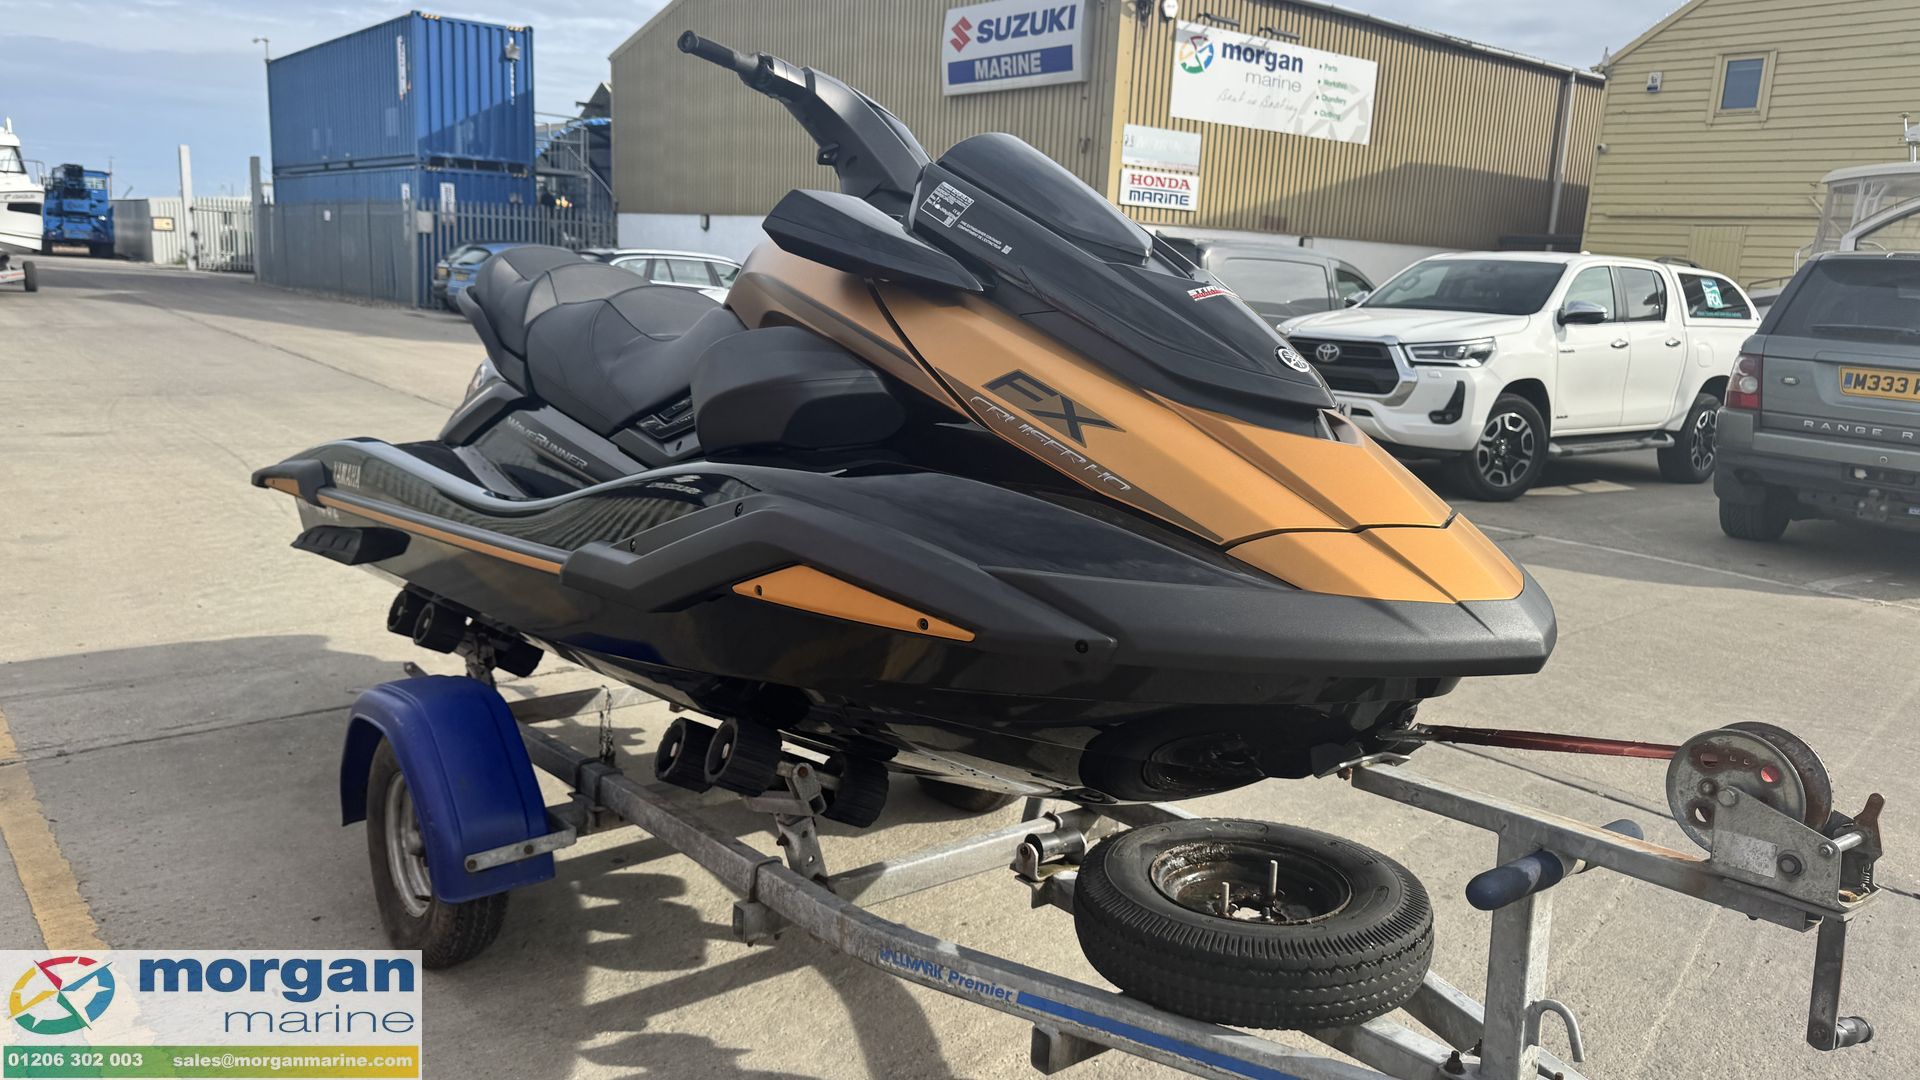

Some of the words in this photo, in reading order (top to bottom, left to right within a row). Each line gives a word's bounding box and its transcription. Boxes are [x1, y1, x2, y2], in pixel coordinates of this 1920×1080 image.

[976, 4, 1077, 44] SUZUKI
[974, 52, 1042, 81] MARINE
[1221, 41, 1304, 73] morgan
[1245, 71, 1302, 93] marine
[1130, 174, 1191, 191] HONDA
[1129, 190, 1190, 206] MARINE
[1853, 373, 1909, 394] M333
[982, 369, 1127, 449] FX
[1803, 419, 1883, 436] RANGE
[948, 969, 1013, 1002] Premier
